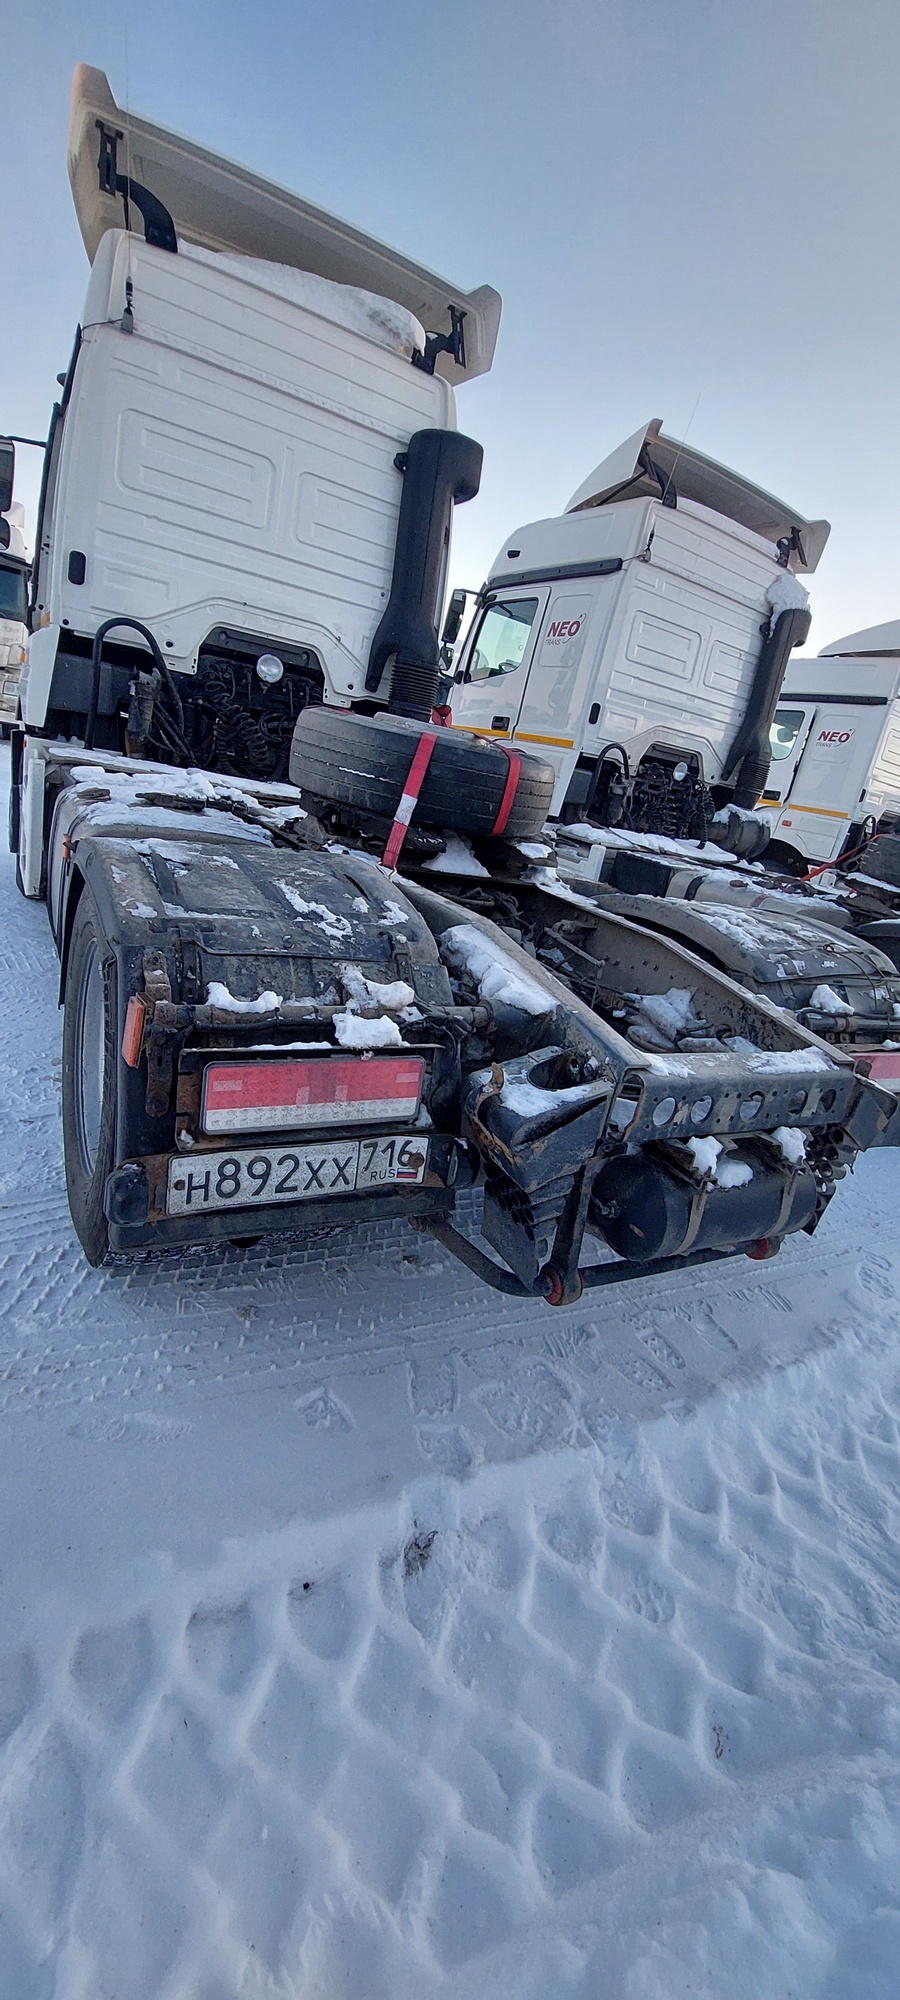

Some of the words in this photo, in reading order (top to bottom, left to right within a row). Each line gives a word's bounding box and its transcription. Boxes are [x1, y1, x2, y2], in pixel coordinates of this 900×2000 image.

[547, 621, 581, 638] NEO
[545, 638, 561, 646] TRANS
[818, 731, 850, 742] NEO
[362, 1139, 414, 1172] 716
[370, 1167, 396, 1182] RUS
